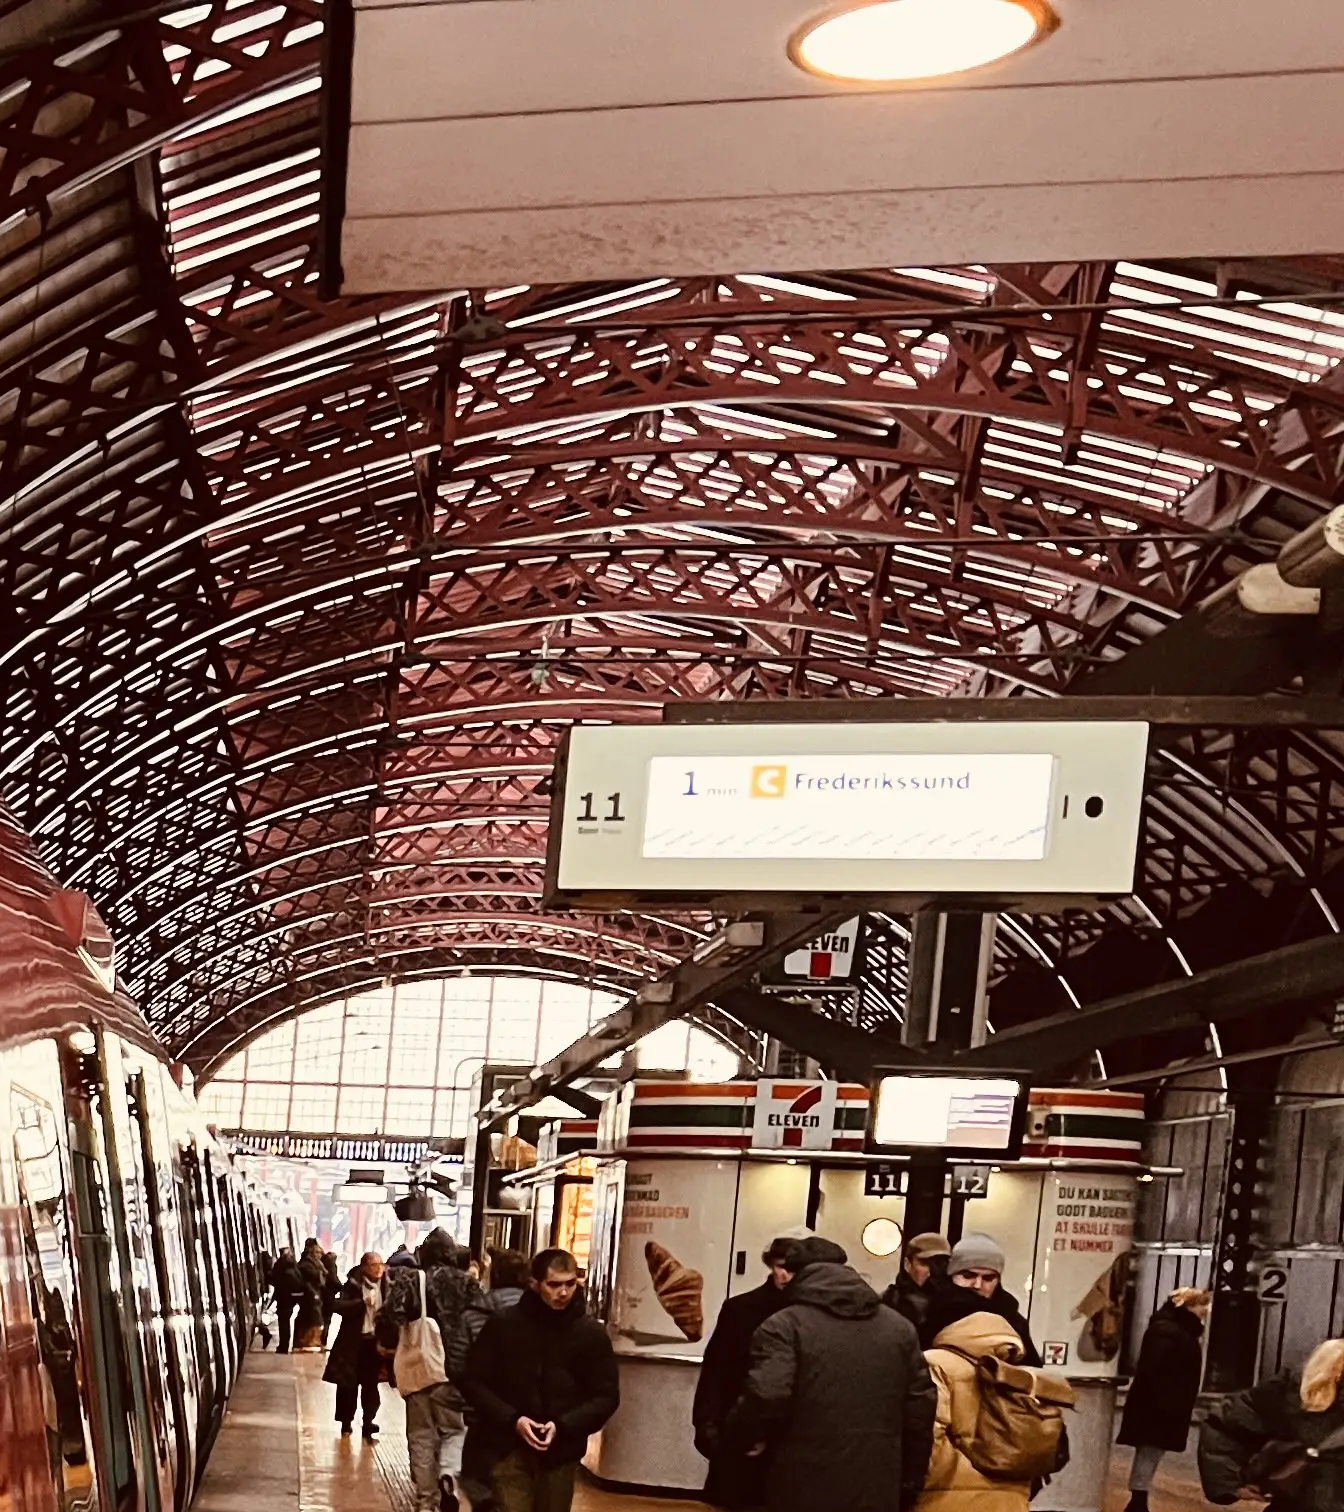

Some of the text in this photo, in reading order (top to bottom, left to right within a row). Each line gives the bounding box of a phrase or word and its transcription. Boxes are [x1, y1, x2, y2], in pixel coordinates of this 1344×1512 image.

[682, 770, 699, 796] 1
[757, 768, 780, 795] C
[795, 772, 970, 791] Frederikssund
[577, 792, 625, 822] 11
[871, 1174, 897, 1191] 11
[957, 1176, 984, 1194] 12
[1262, 1270, 1287, 1299] 2
